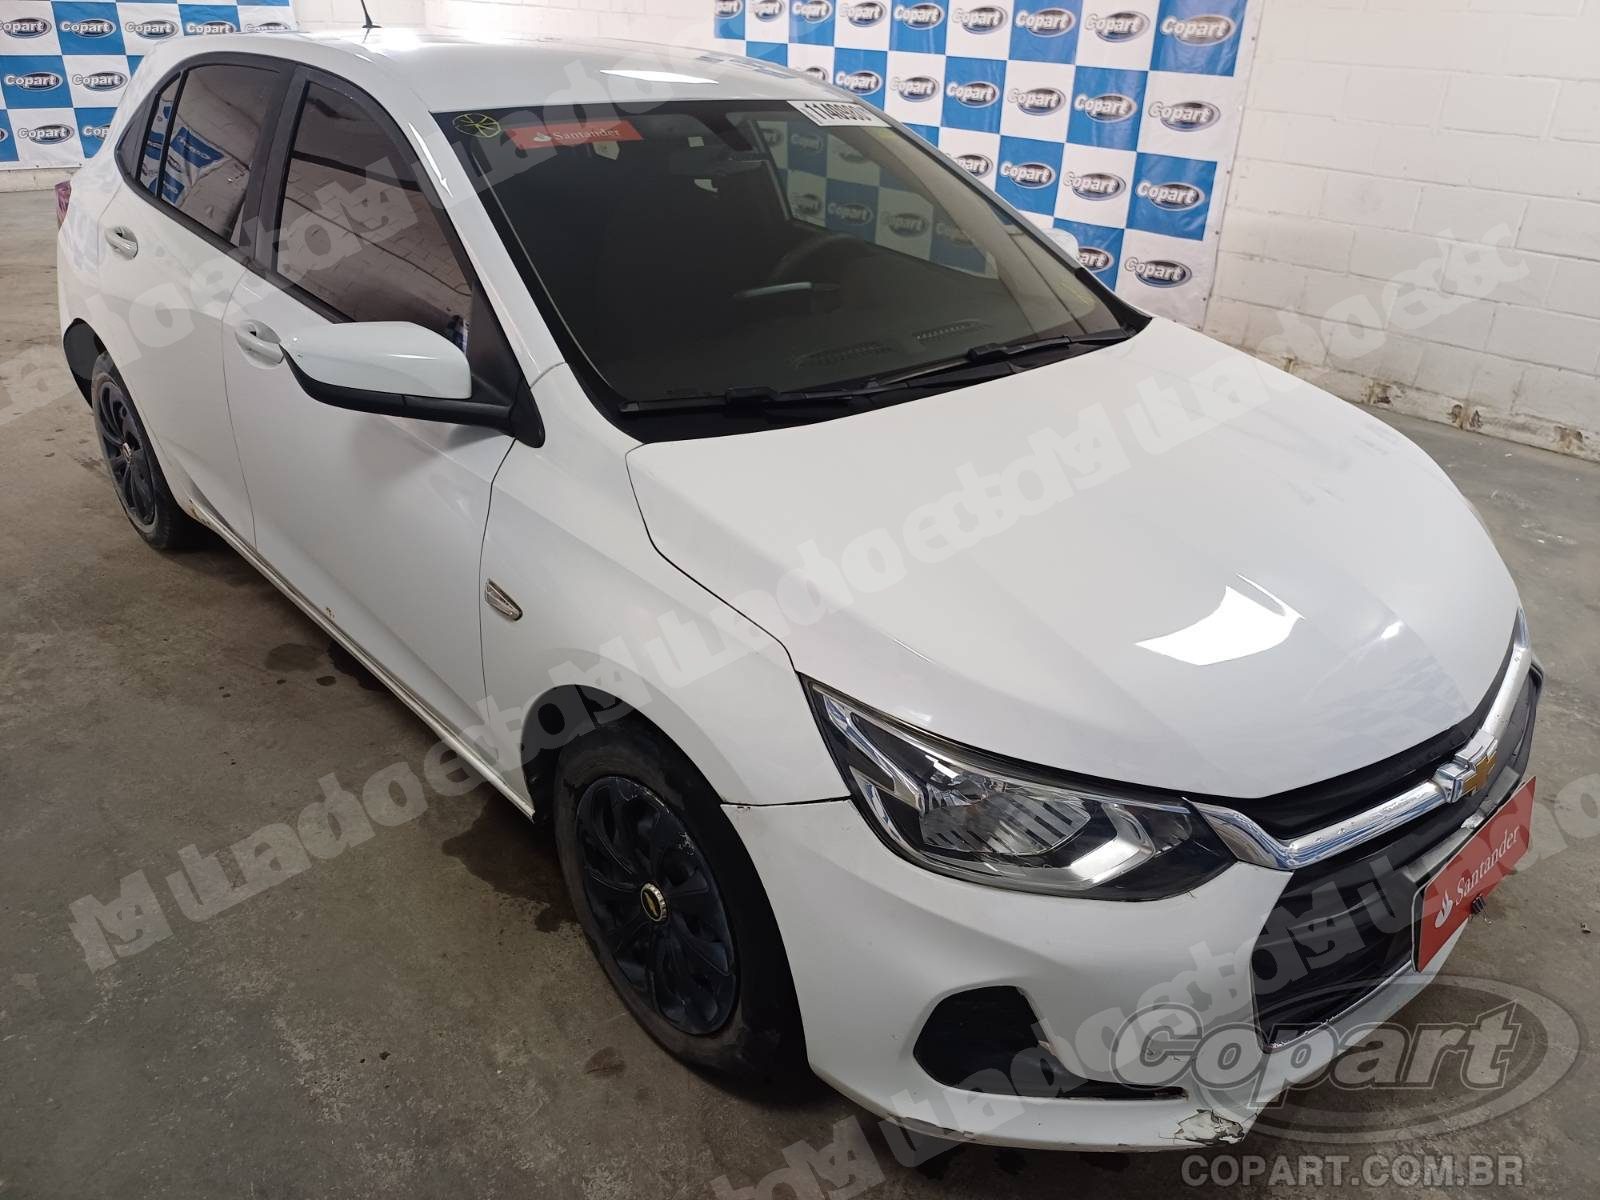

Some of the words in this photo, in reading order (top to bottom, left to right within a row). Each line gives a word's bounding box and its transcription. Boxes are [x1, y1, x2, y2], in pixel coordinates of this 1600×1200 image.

[840, 3, 881, 21] Copart
[895, 6, 941, 23] Copart
[952, 11, 1000, 27] Copart
[1016, 10, 1068, 29] Copart
[0, 17, 44, 33] opart
[60, 20, 110, 35] Copart
[125, 22, 173, 37] Copart
[1085, 14, 1139, 33] Copart
[1161, 17, 1226, 38] Copart
[4, 75, 56, 90] Copart
[72, 74, 121, 88] Copart
[836, 73, 876, 90] Copart
[890, 77, 935, 96] Copart
[947, 84, 994, 102] Copart
[1008, 89, 1060, 108] Copart
[1074, 94, 1130, 115] Copart
[1148, 101, 1212, 122] Copart
[19, 126, 68, 141] Copart
[83, 126, 110, 139] Cop
[552, 127, 620, 141] Santander
[954, 157, 986, 171] part
[1000, 161, 1051, 182] Copart
[1064, 171, 1119, 193] Copart
[1136, 181, 1196, 205] Copart
[1078, 253, 1106, 268] art
[1124, 256, 1183, 283] Copart
[1455, 824, 1520, 906] Santander
